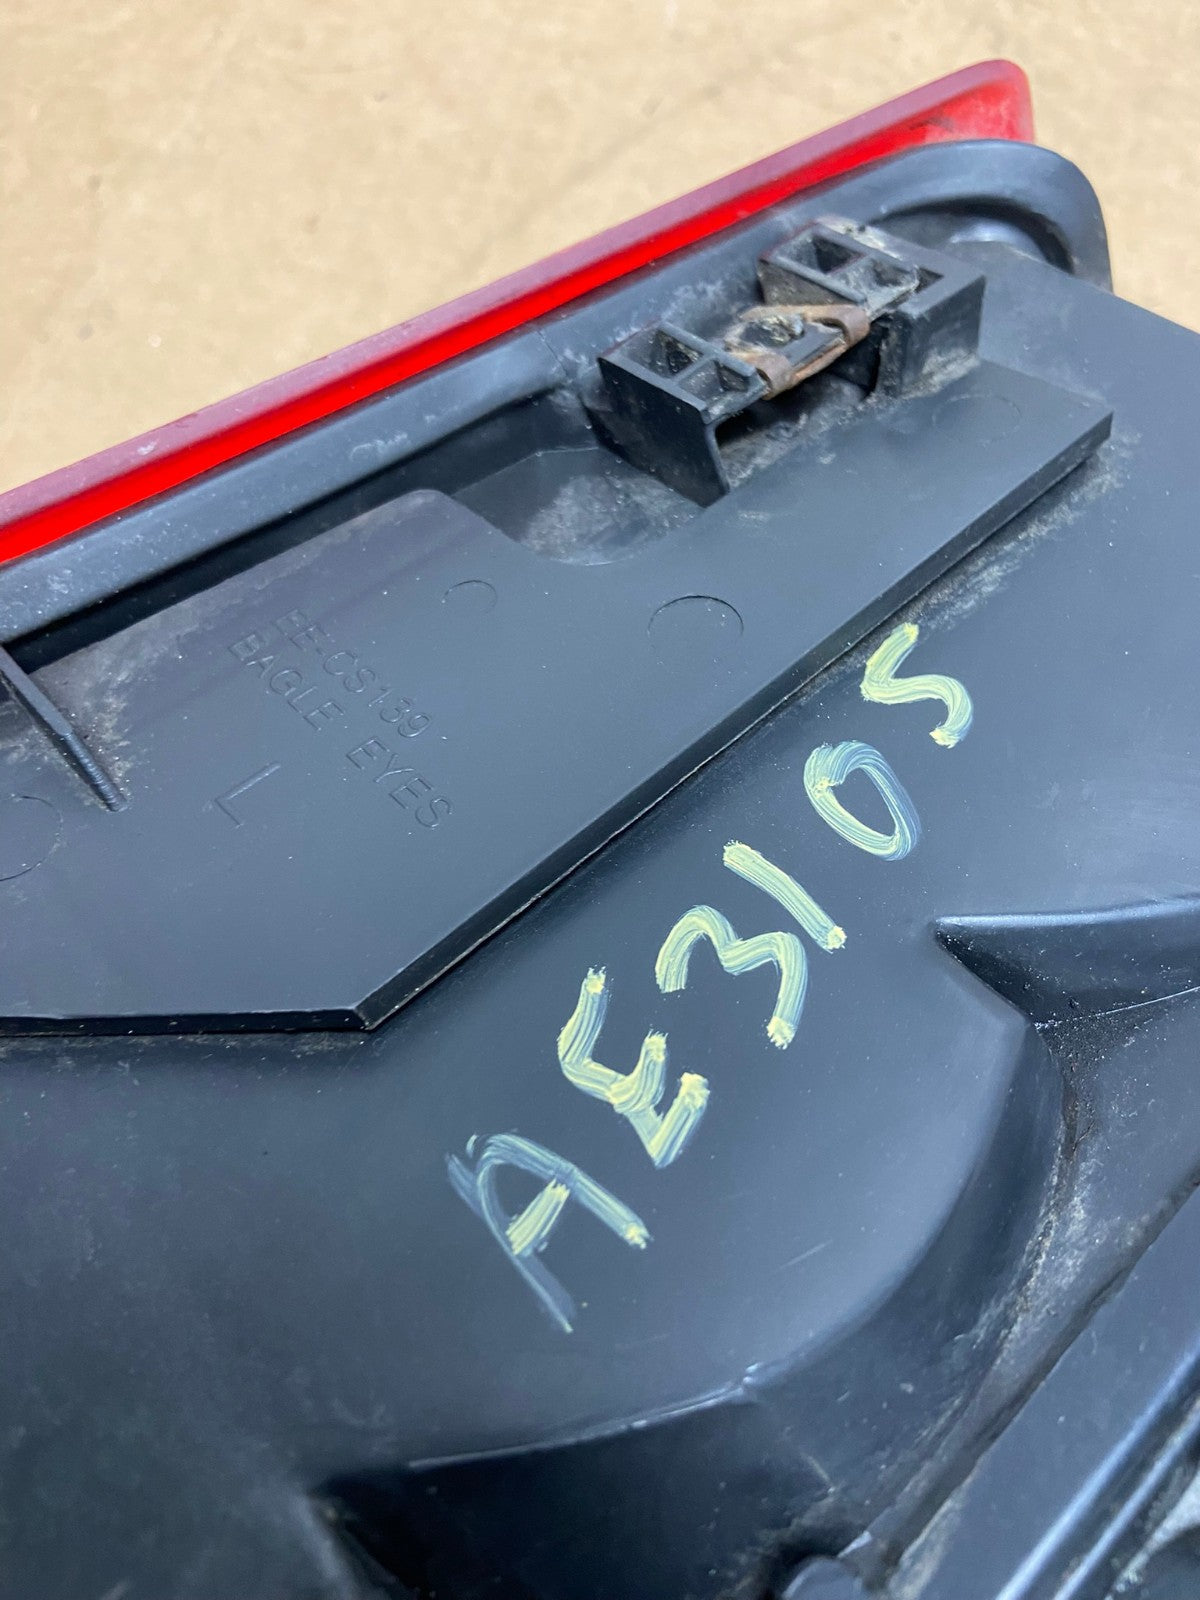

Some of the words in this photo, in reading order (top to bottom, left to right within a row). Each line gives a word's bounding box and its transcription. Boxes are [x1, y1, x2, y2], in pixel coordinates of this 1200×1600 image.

[215, 761, 281, 828] L
[228, 634, 345, 732] EAGLE
[346, 737, 452, 828] EYES
